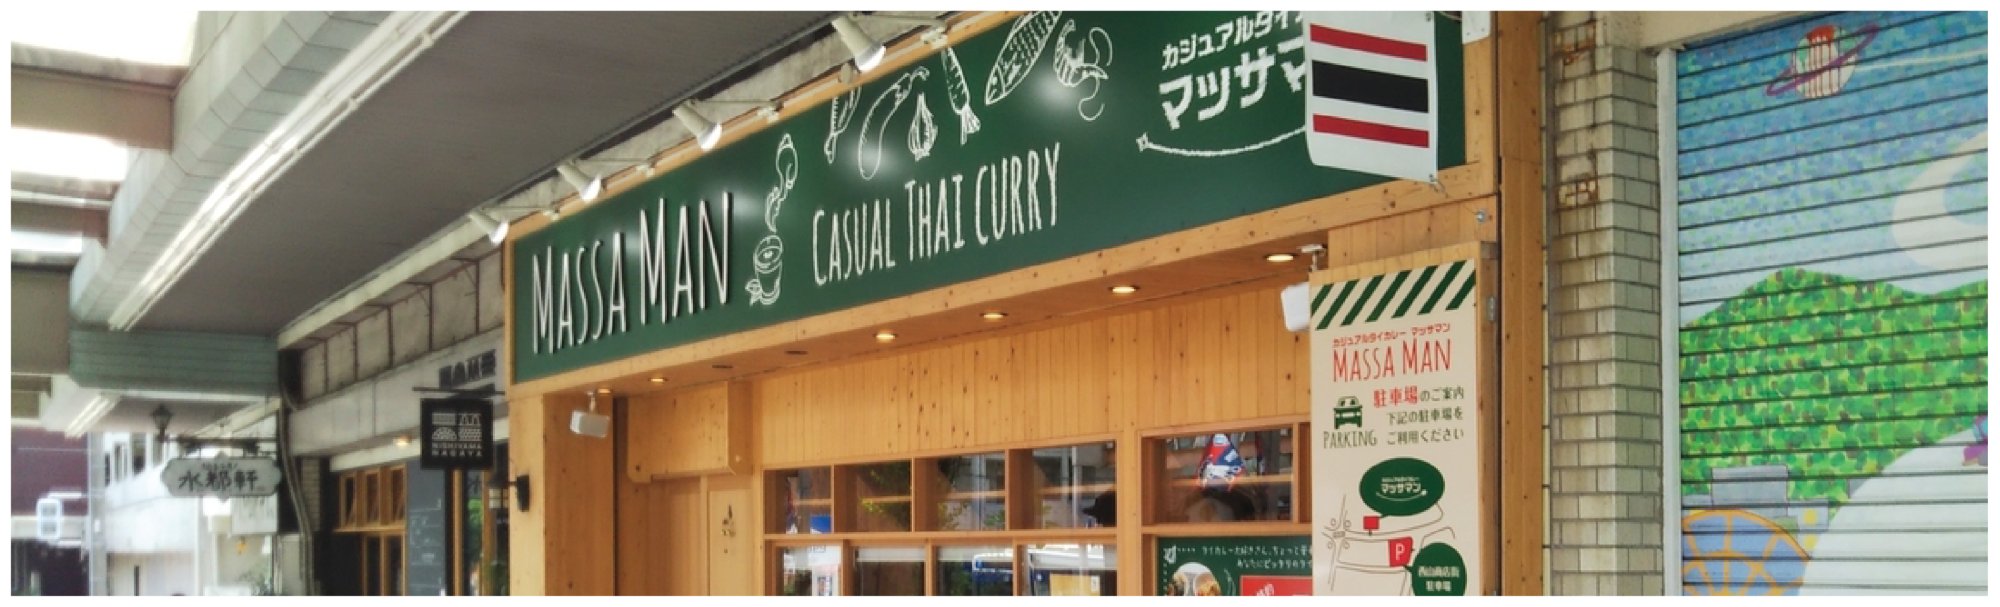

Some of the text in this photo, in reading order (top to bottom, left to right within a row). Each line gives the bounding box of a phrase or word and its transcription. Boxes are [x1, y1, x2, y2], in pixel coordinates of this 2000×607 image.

[1161, 11, 1302, 70] カジュアルタイ
[975, 142, 1060, 247] CURRY
[1412, 323, 1450, 336] マッサマン
[1333, 337, 1451, 382] MASSA MAN
[1388, 407, 1463, 425] 下記の駐車場を
[1323, 430, 1378, 449] PARKING
[1387, 428, 1464, 445] ご利用ください
[1396, 543, 1405, 561] P
